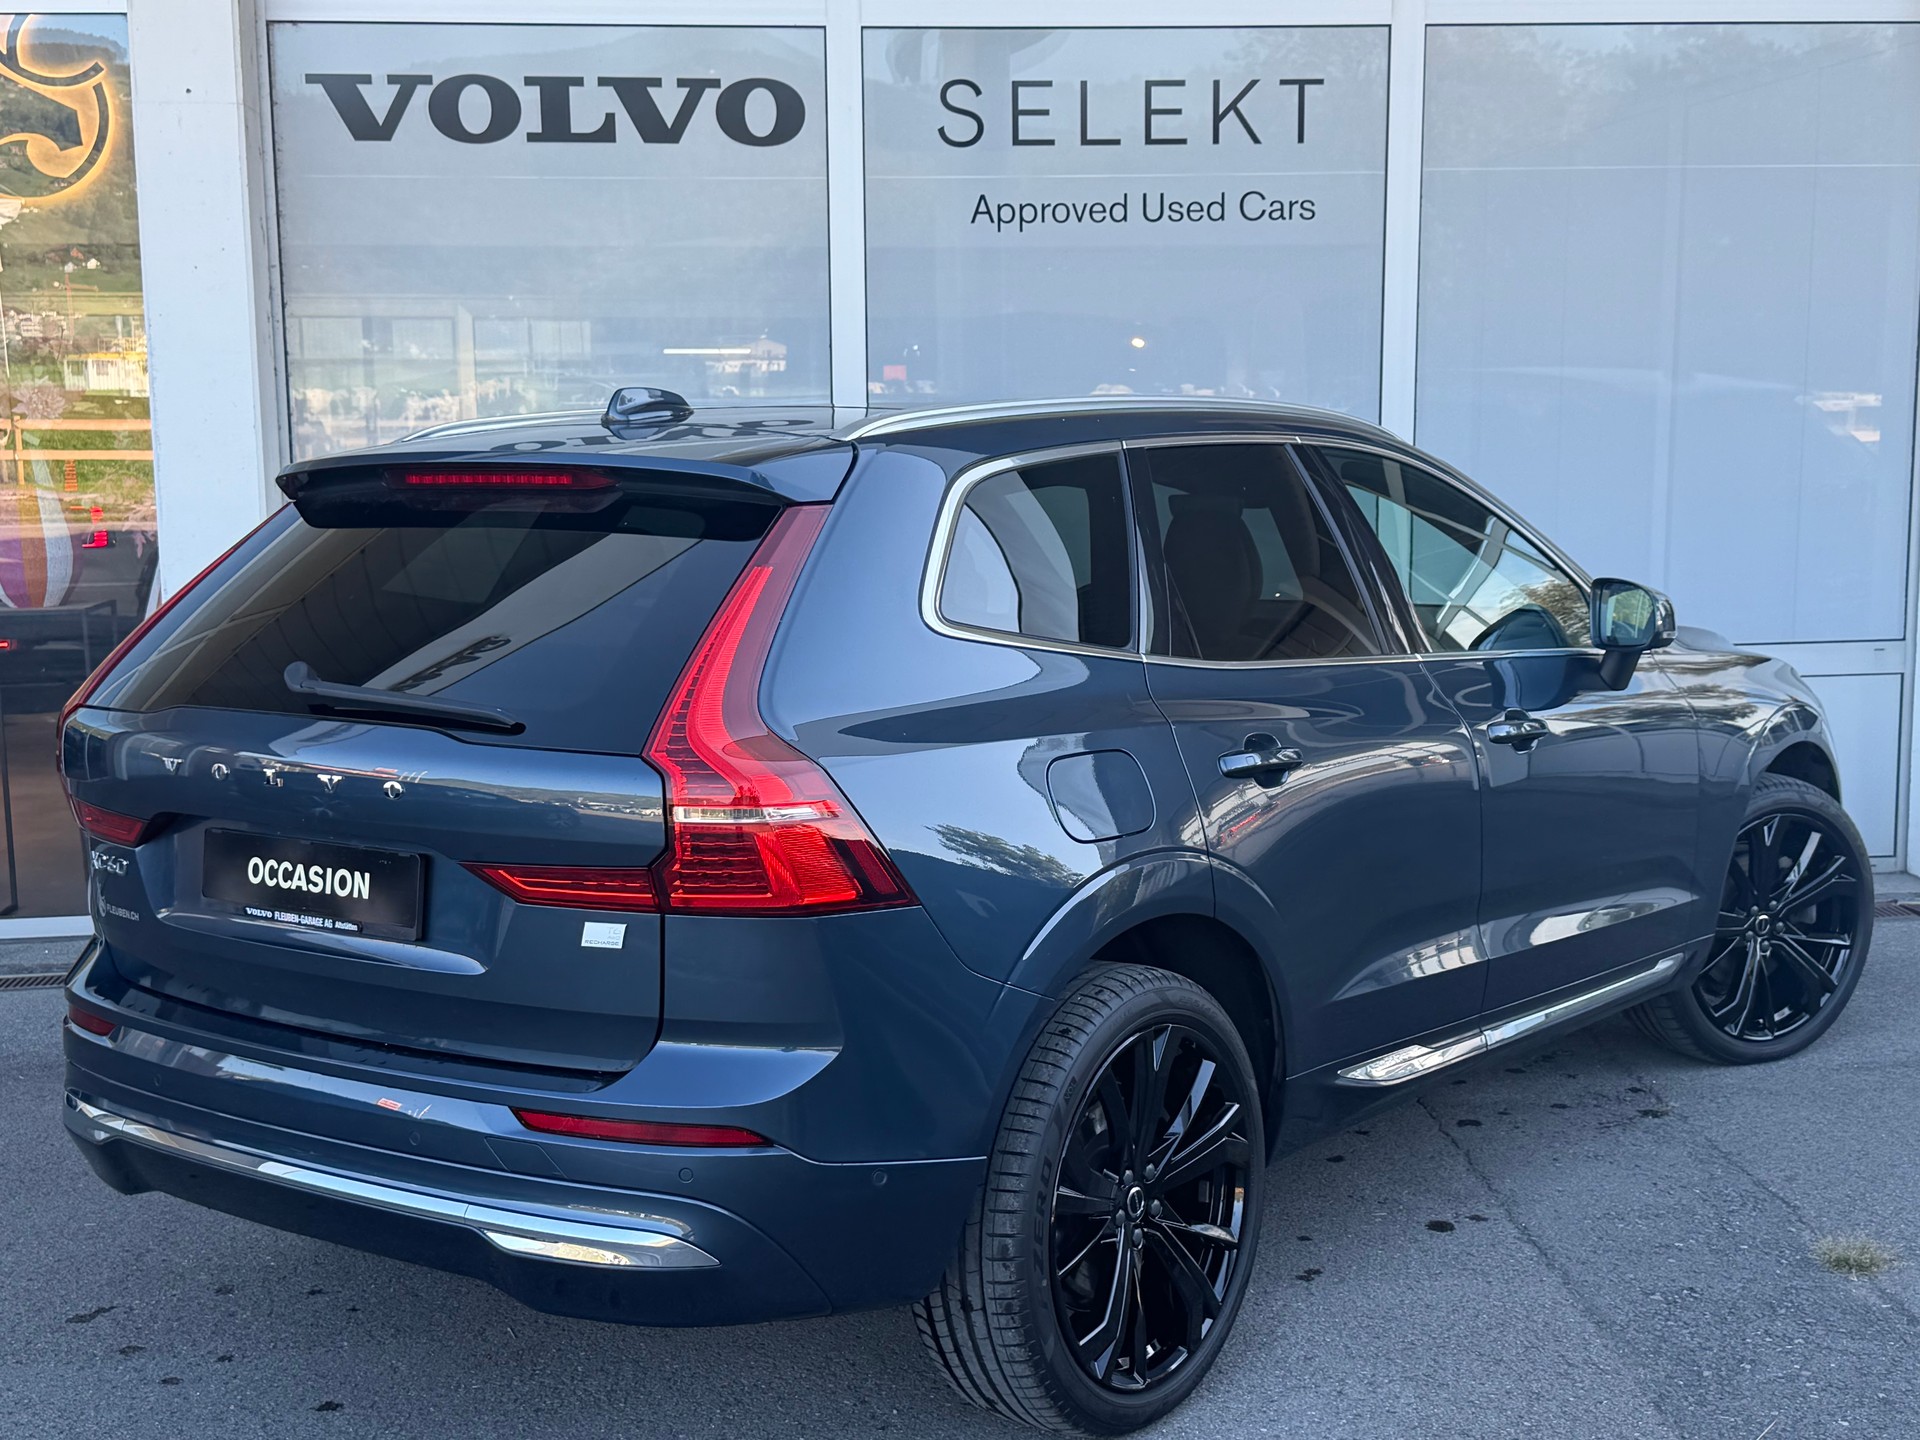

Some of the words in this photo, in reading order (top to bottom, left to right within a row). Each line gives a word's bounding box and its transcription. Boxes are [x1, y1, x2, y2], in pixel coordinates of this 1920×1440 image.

[304, 73, 806, 147] VOLVO
[937, 78, 1325, 148] SELEKT
[970, 192, 1128, 233] Approved
[1142, 191, 1226, 223] Used
[1239, 190, 1317, 222] Cars
[162, 757, 406, 801] VOLVO
[91, 850, 130, 876] XC60
[247, 856, 370, 900] OCCASION
[245, 907, 273, 918] VOLVO
[324, 918, 334, 929] AG
[1032, 1155, 1053, 1276] ZERO
